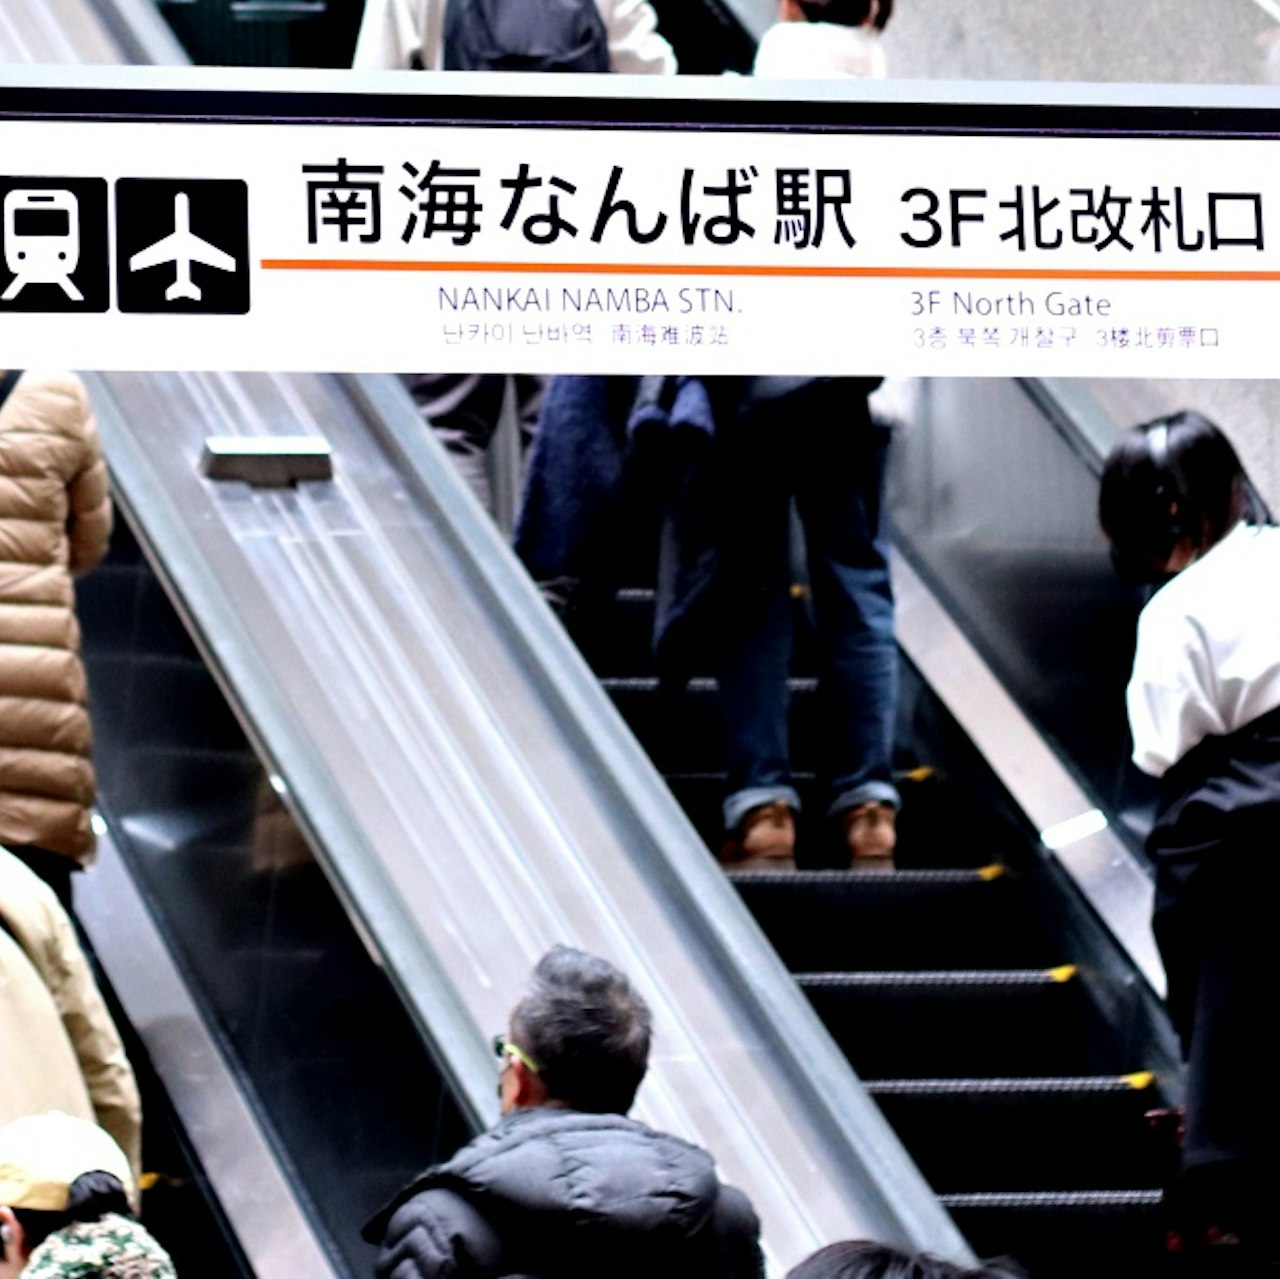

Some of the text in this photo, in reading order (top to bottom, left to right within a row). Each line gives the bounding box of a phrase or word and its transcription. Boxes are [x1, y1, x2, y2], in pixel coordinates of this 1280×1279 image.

[302, 158, 856, 249] 南海なんば駅
[901, 185, 1264, 252] 3F北改札口
[439, 287, 741, 313] NANKAI NAMBA STN.
[912, 291, 1110, 315] 3F North Gate
